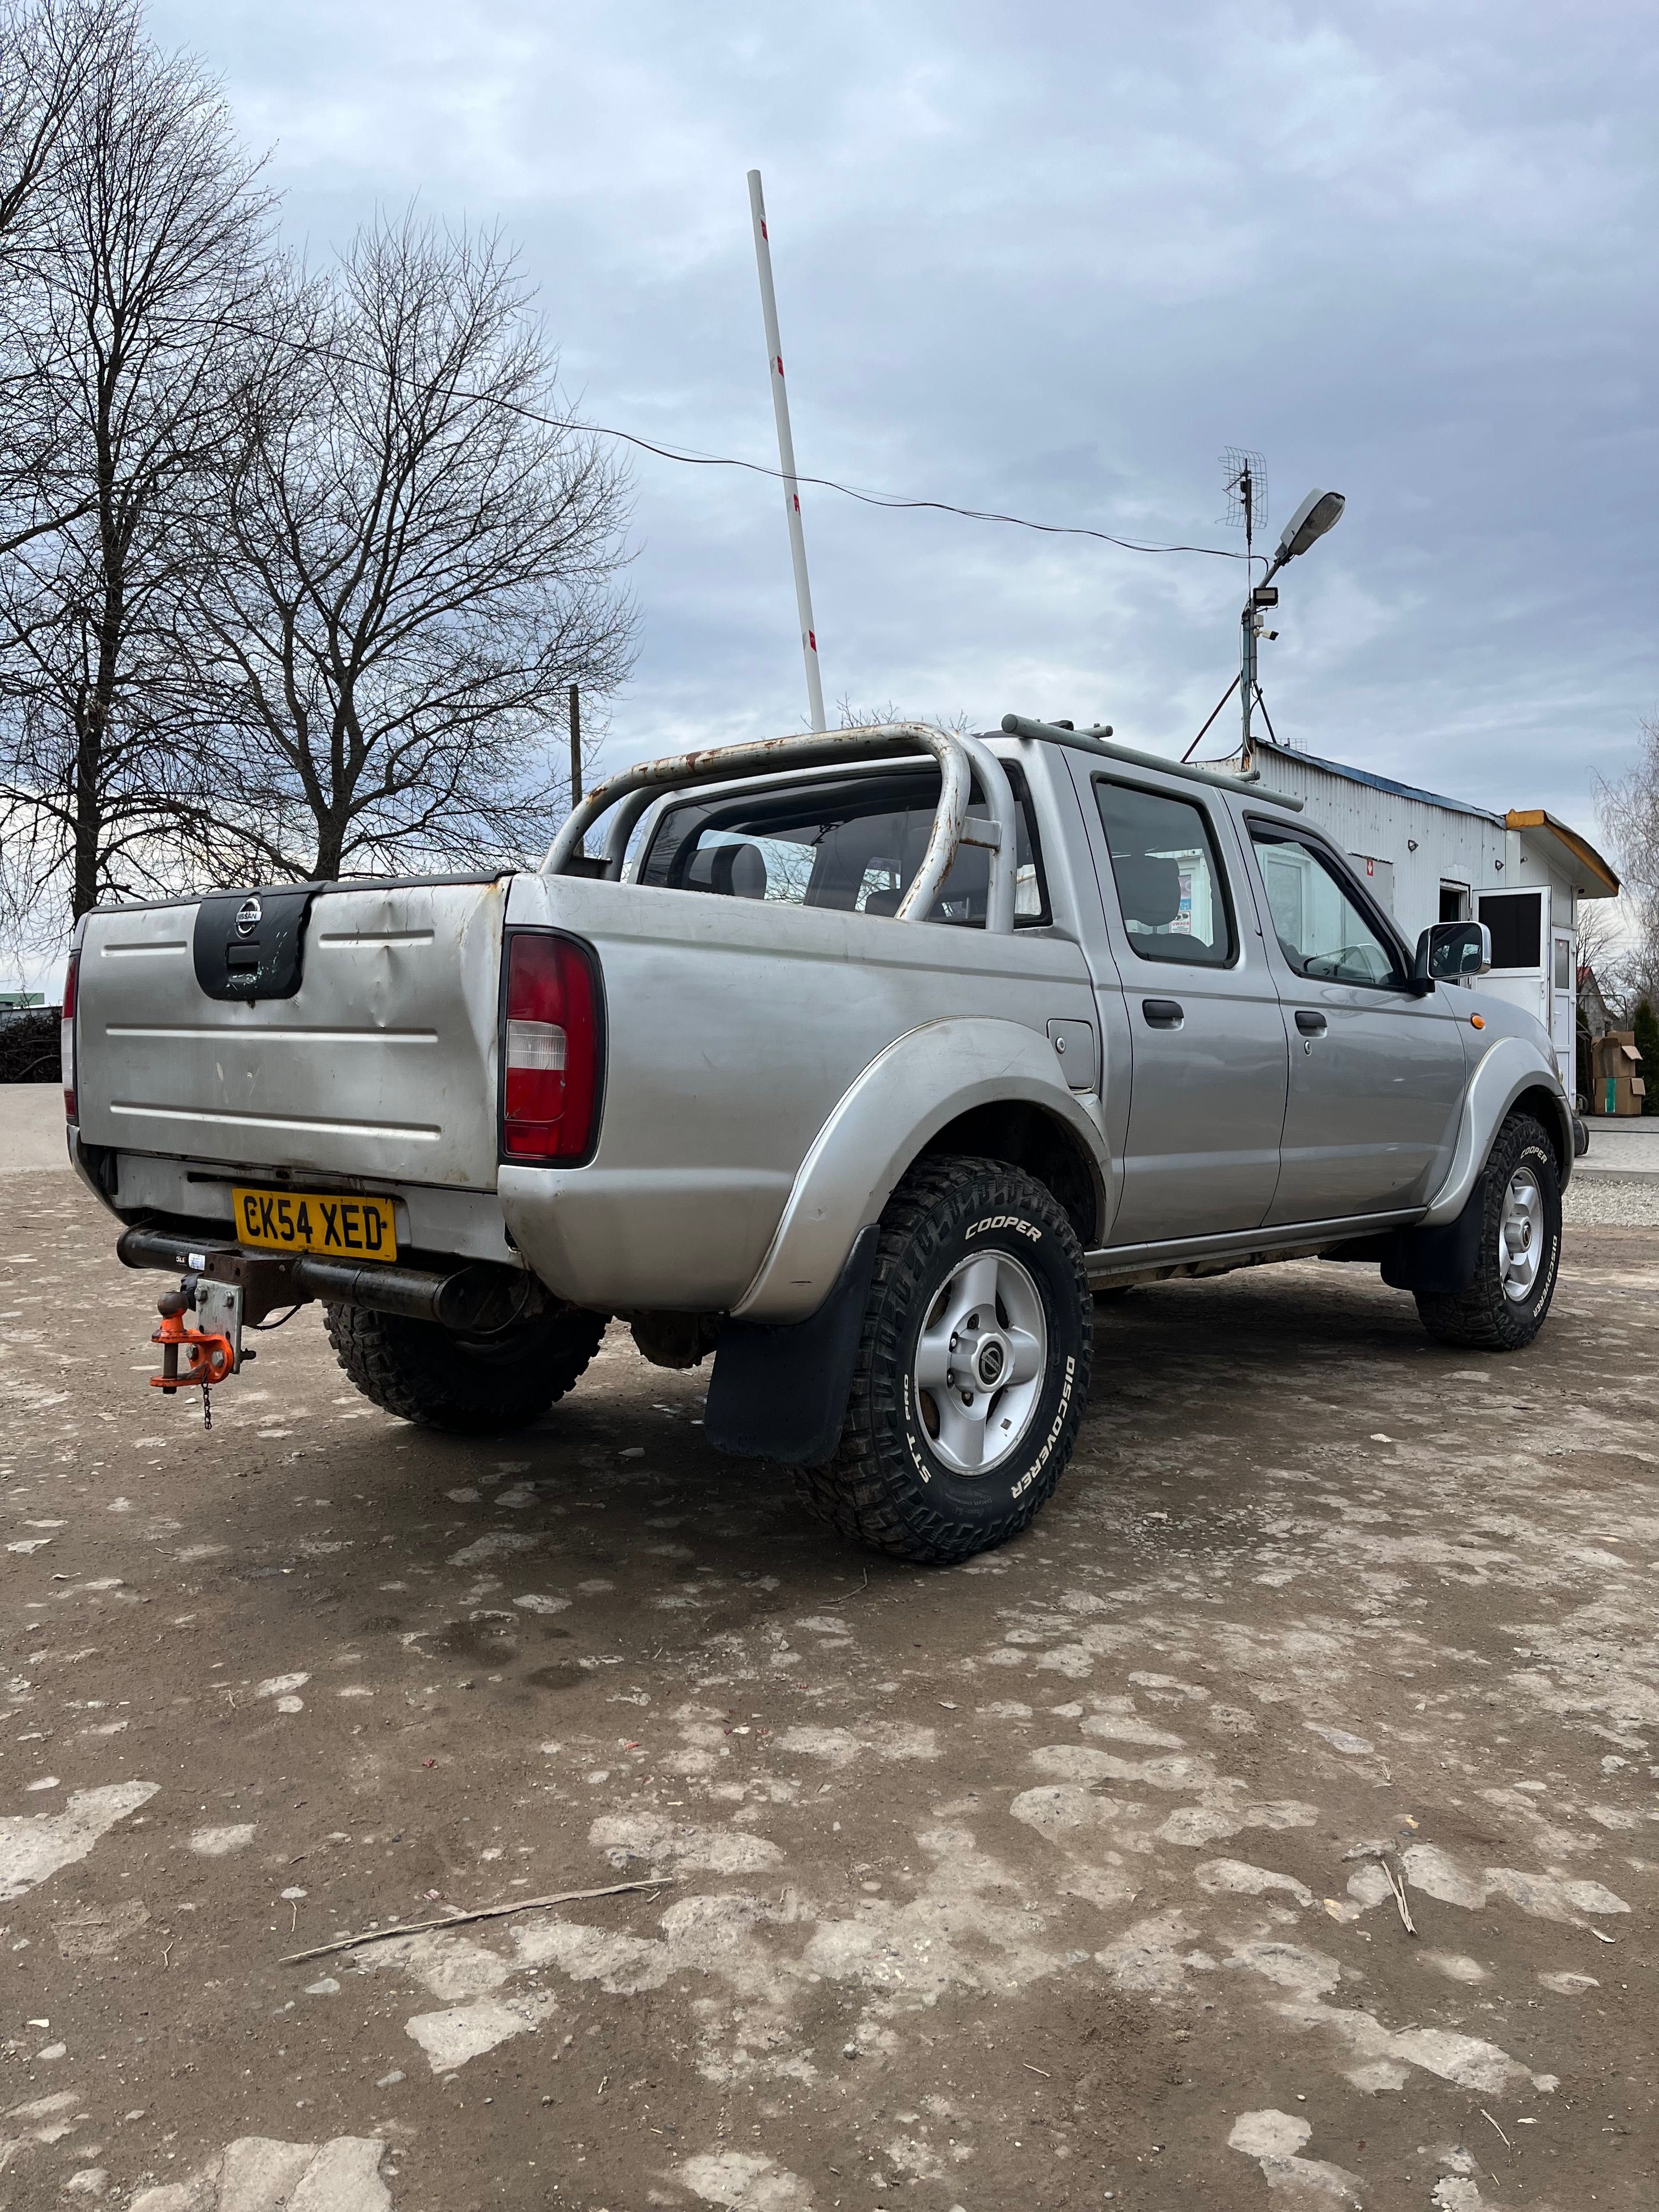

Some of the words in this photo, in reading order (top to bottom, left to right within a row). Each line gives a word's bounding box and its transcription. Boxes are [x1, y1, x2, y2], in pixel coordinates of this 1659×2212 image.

[1520, 1146, 1547, 1164] COOPER
[244, 1195, 313, 1244] CK54
[320, 1203, 382, 1251] XED
[965, 1216, 1042, 1243] COOPER
[1533, 1235, 1558, 1317] DISCOVERER
[1011, 1356, 1075, 1499] DISCOVERER
[906, 1432, 932, 1483] STT
